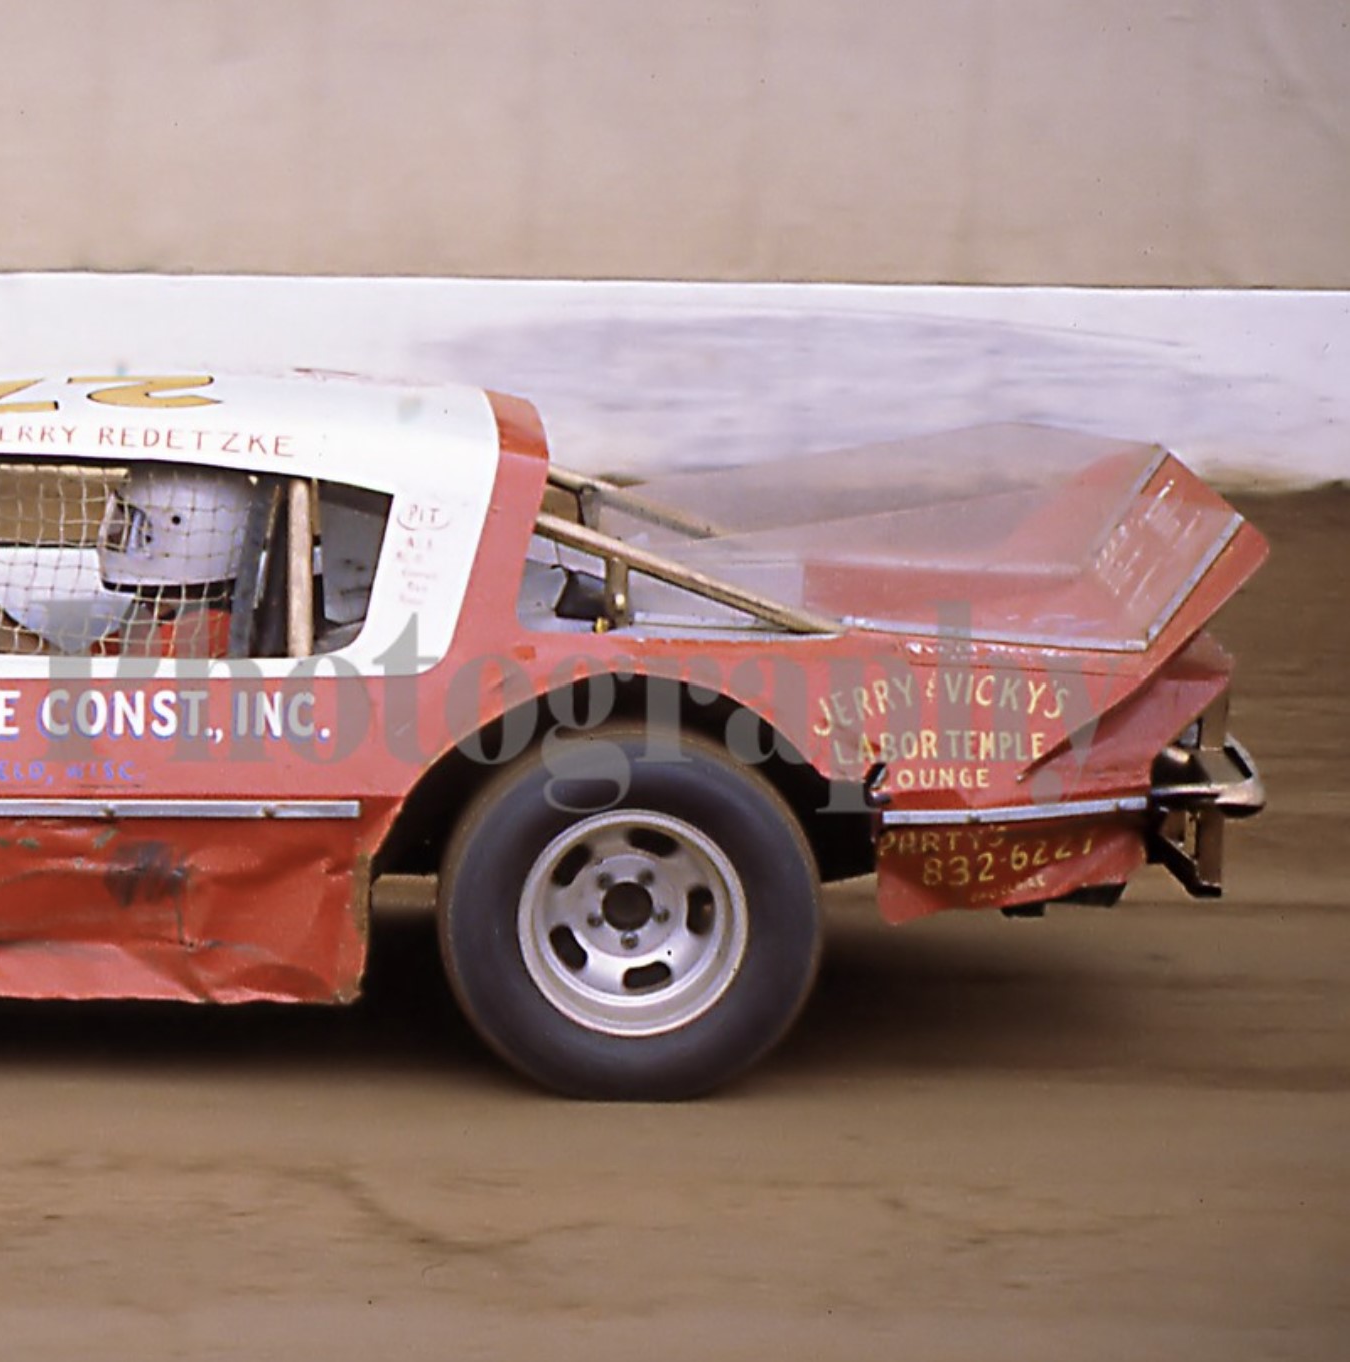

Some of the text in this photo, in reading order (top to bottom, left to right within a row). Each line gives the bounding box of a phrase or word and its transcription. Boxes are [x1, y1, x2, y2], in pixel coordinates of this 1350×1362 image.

[98, 426, 297, 457] REDETZKE
[233, 689, 331, 741] INC.
[813, 674, 914, 736] JERRY
[944, 672, 1071, 719] VICKY'S
[833, 730, 1046, 765] LABOR TEMPLE
[876, 767, 990, 791] OUNGE
